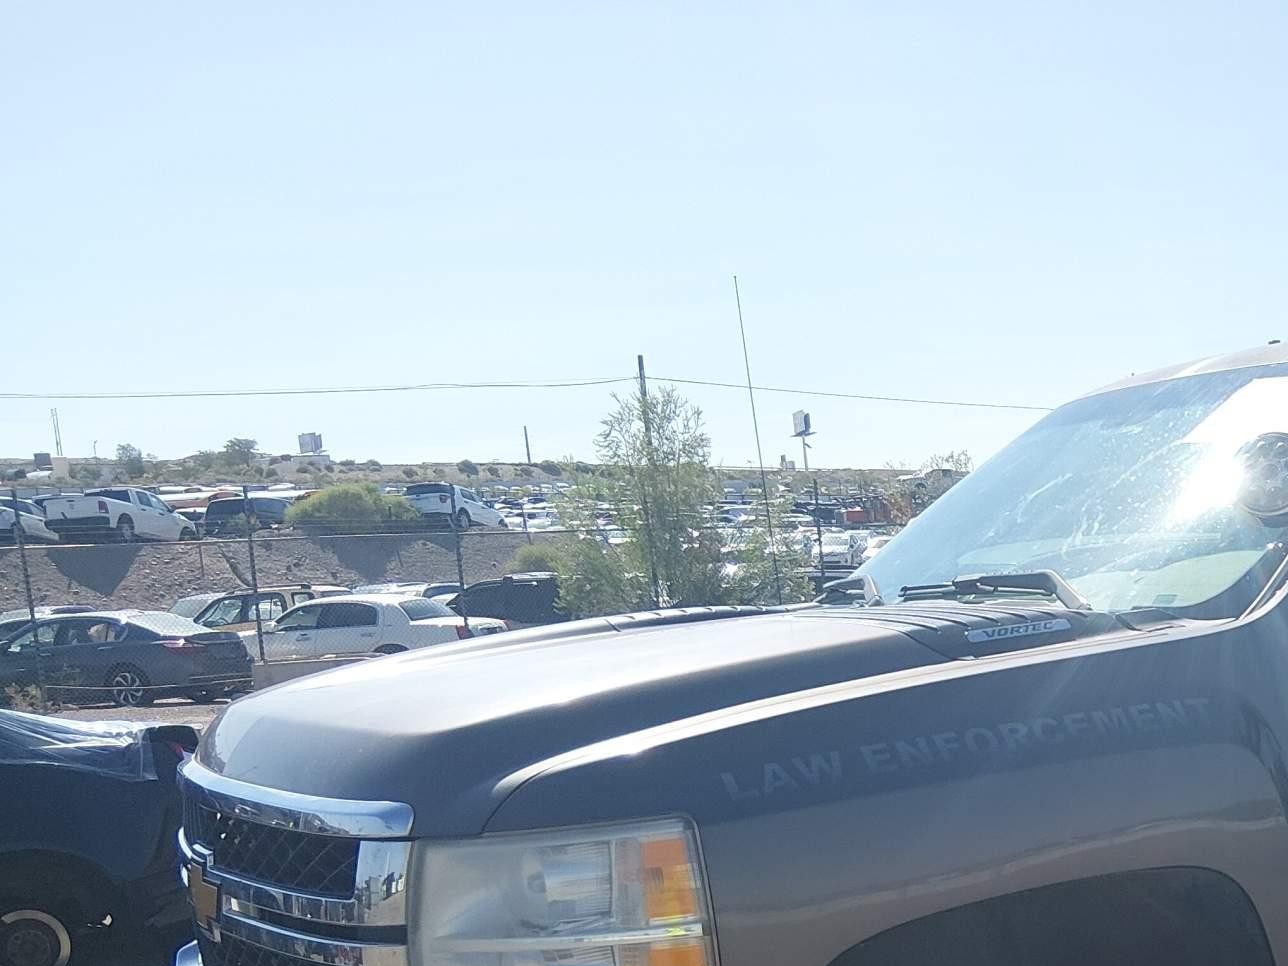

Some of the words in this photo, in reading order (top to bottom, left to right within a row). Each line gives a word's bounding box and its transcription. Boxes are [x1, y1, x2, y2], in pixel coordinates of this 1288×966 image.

[982, 621, 1055, 638] VORTEC
[719, 750, 842, 802] LAW
[860, 697, 1211, 775] ENFORCEMENT
